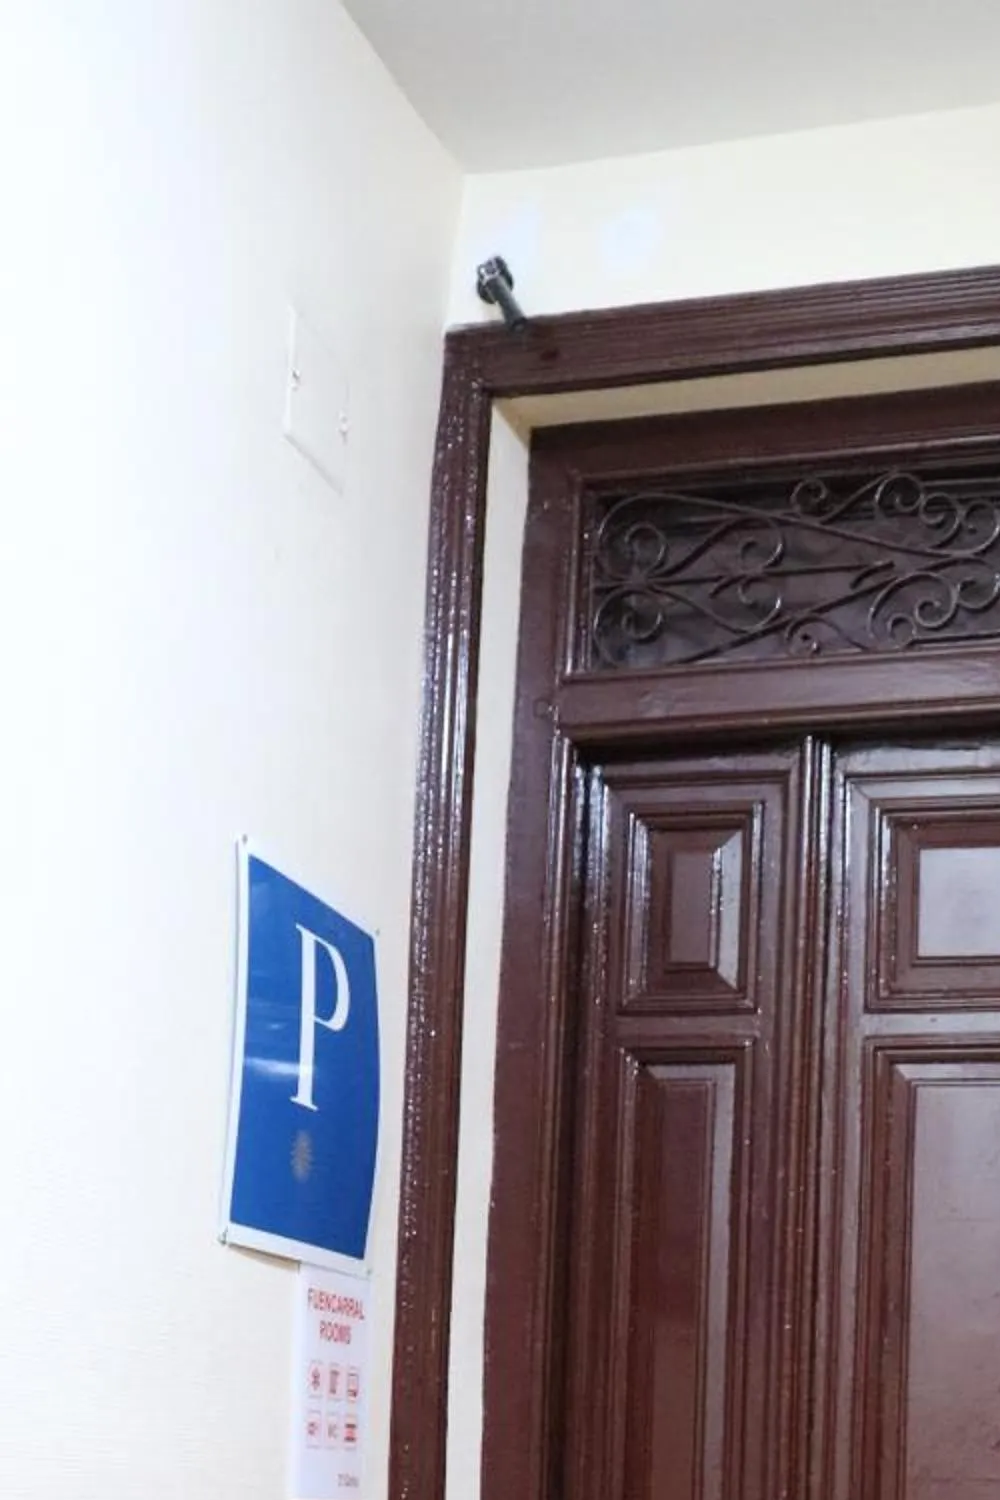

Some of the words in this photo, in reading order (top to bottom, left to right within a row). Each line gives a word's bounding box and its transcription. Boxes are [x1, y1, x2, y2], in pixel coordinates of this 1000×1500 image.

[290, 923, 350, 1110] P
[308, 1287, 364, 1320] FUENCARRAL
[320, 1320, 351, 1344] ROOMS
